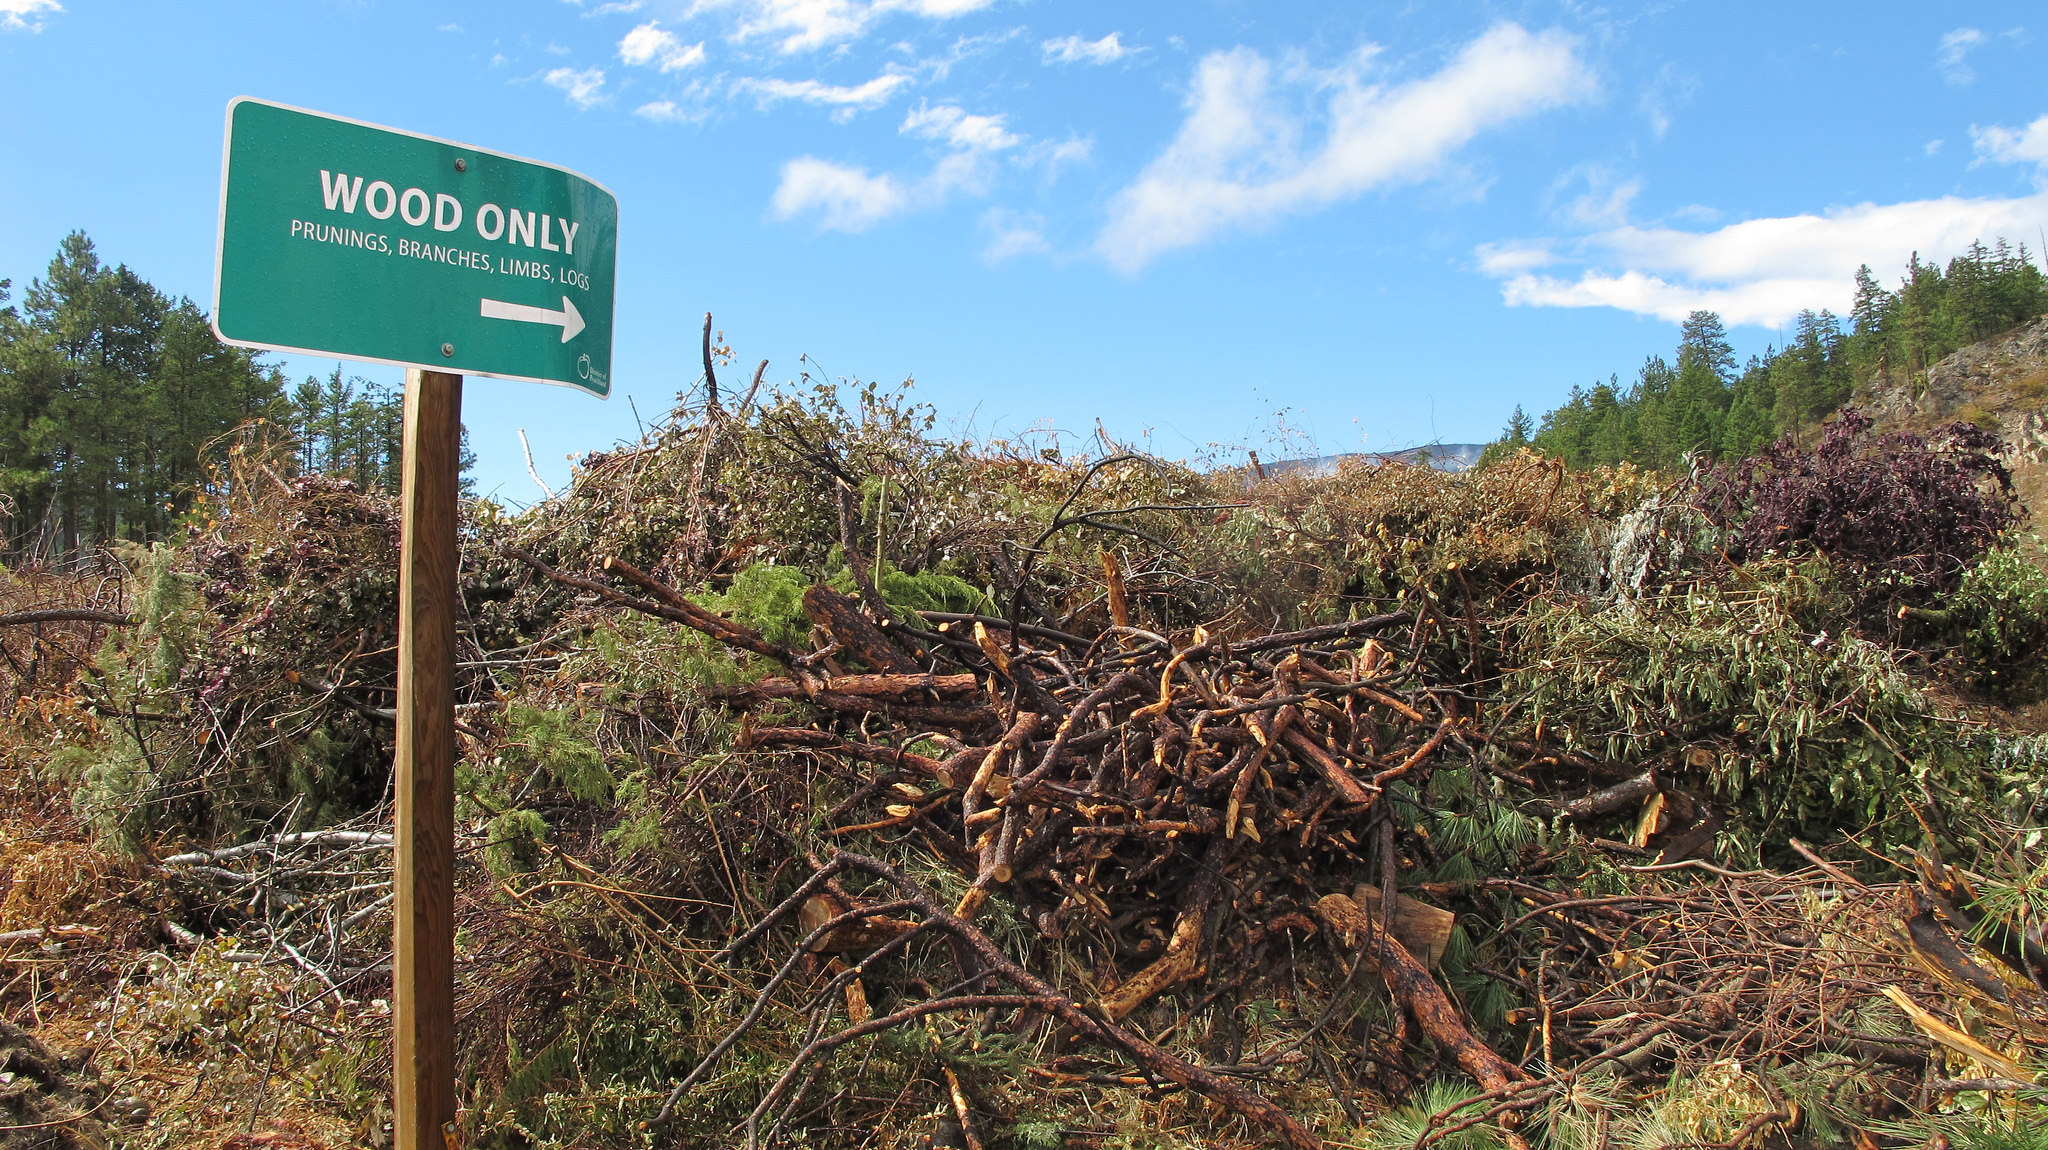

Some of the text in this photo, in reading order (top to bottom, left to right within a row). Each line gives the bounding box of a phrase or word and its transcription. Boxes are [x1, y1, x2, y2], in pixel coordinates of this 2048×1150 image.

[320, 169, 580, 255] WOOD ONLY
[291, 219, 590, 291] PRUNINGS, BRANCHES, LIMBS, LOGS
